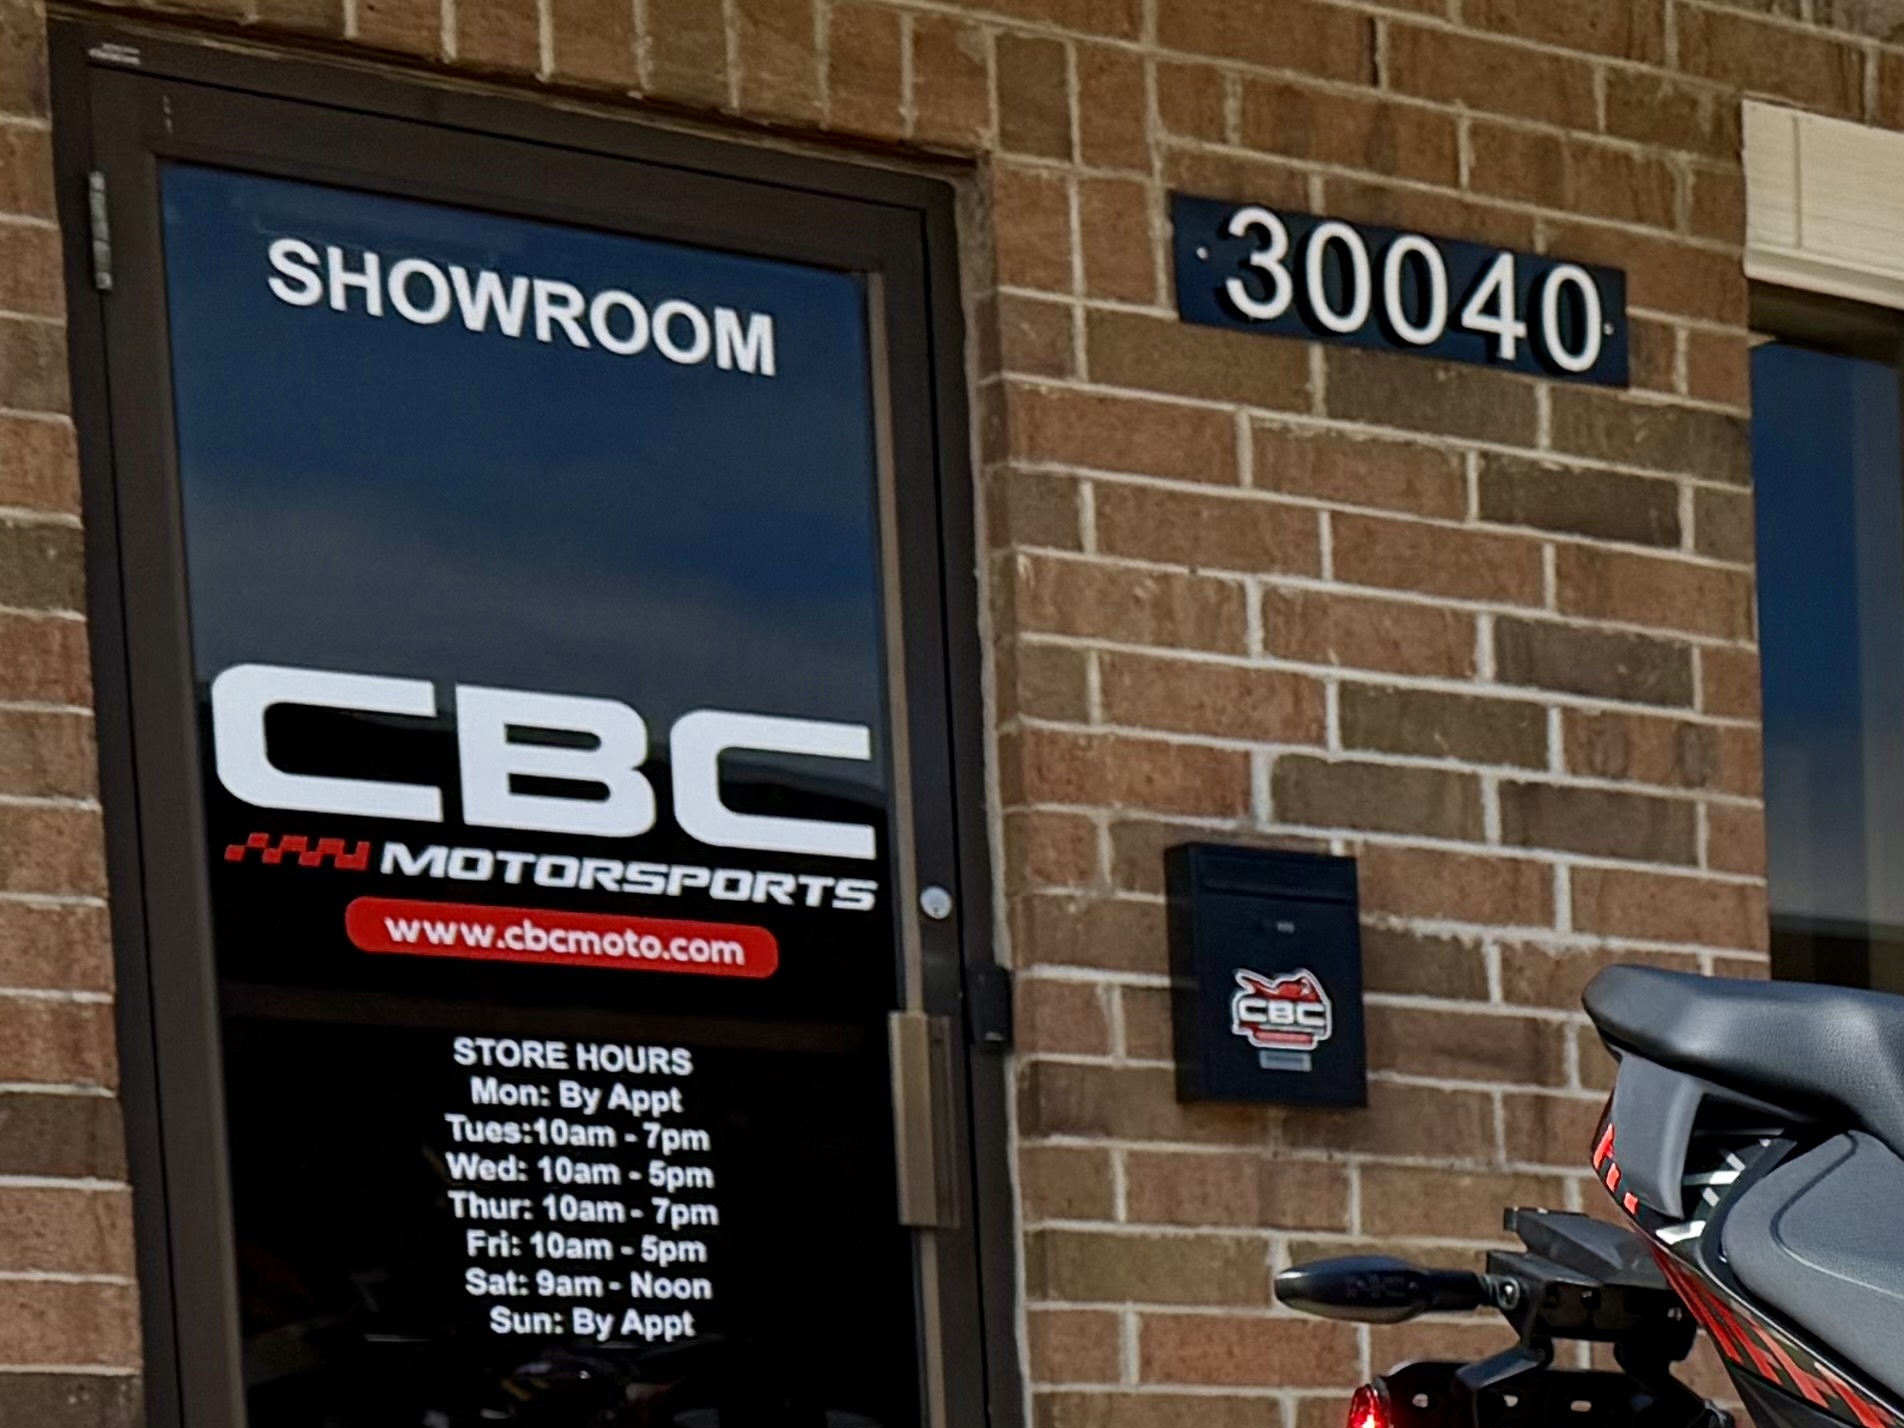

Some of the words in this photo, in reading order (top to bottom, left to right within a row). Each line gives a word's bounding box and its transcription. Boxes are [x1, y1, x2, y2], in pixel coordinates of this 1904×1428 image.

[266, 237, 776, 377] SHOWROOM
[1226, 206, 1601, 373] 30040
[211, 662, 877, 860] CBC
[380, 842, 878, 912] MOTORSPORTS
[385, 915, 745, 966] www.cbcmoto.com
[1238, 997, 1326, 1028] CBC
[454, 1037, 569, 1069] STORE
[577, 1043, 693, 1076] HOURS
[470, 1076, 550, 1106] Mon:
[559, 1080, 600, 1115] By
[608, 1082, 684, 1117] Appt
[643, 1122, 711, 1156] 7pm
[446, 1152, 528, 1182] Wed:
[538, 1156, 621, 1185] 10am
[649, 1160, 715, 1193] 5pm
[447, 1190, 533, 1220] Thur:
[543, 1194, 626, 1223] 10am
[652, 1197, 720, 1231] 7pm
[466, 1229, 522, 1257] Fri:
[530, 1231, 614, 1260] 10am
[641, 1235, 708, 1268] 5pm
[465, 1267, 529, 1296] Sat:
[535, 1269, 604, 1297] 9am
[630, 1271, 713, 1300] Noon
[490, 1305, 564, 1335] Sun:
[572, 1307, 615, 1342] By
[620, 1309, 696, 1342] Appt
